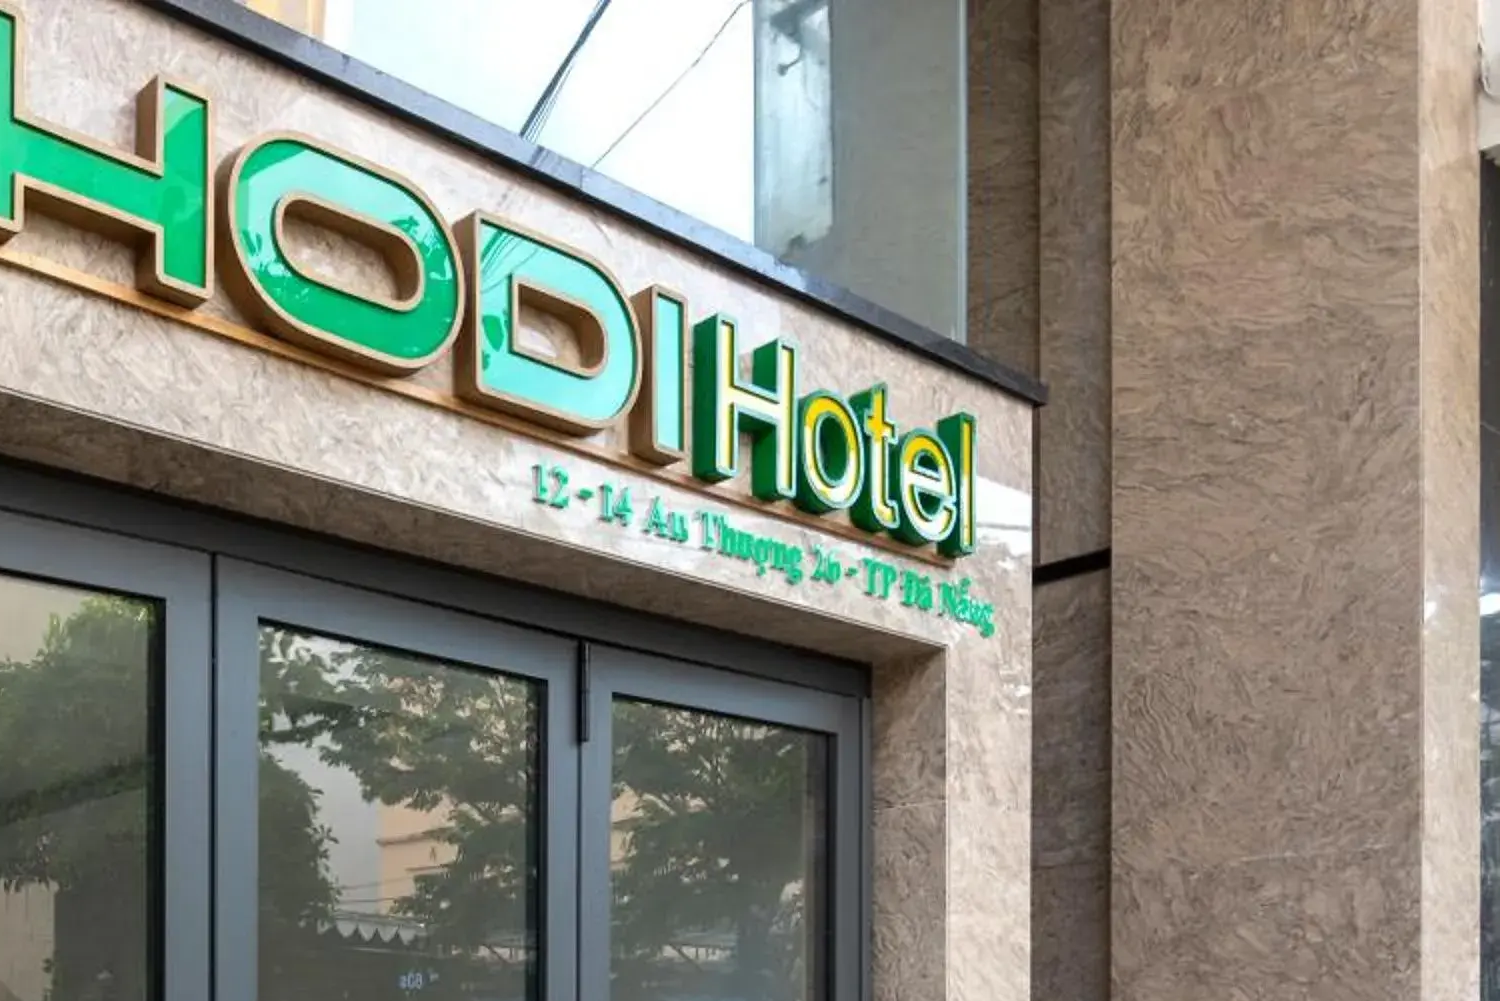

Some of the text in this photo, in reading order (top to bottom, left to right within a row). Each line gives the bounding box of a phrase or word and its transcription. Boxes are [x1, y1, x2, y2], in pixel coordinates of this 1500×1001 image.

[692, 313, 977, 557] Hotel
[532, 464, 570, 509] 12
[599, 481, 633, 527] 14
[809, 543, 841, 584] 26
[862, 556, 898, 600] TP
